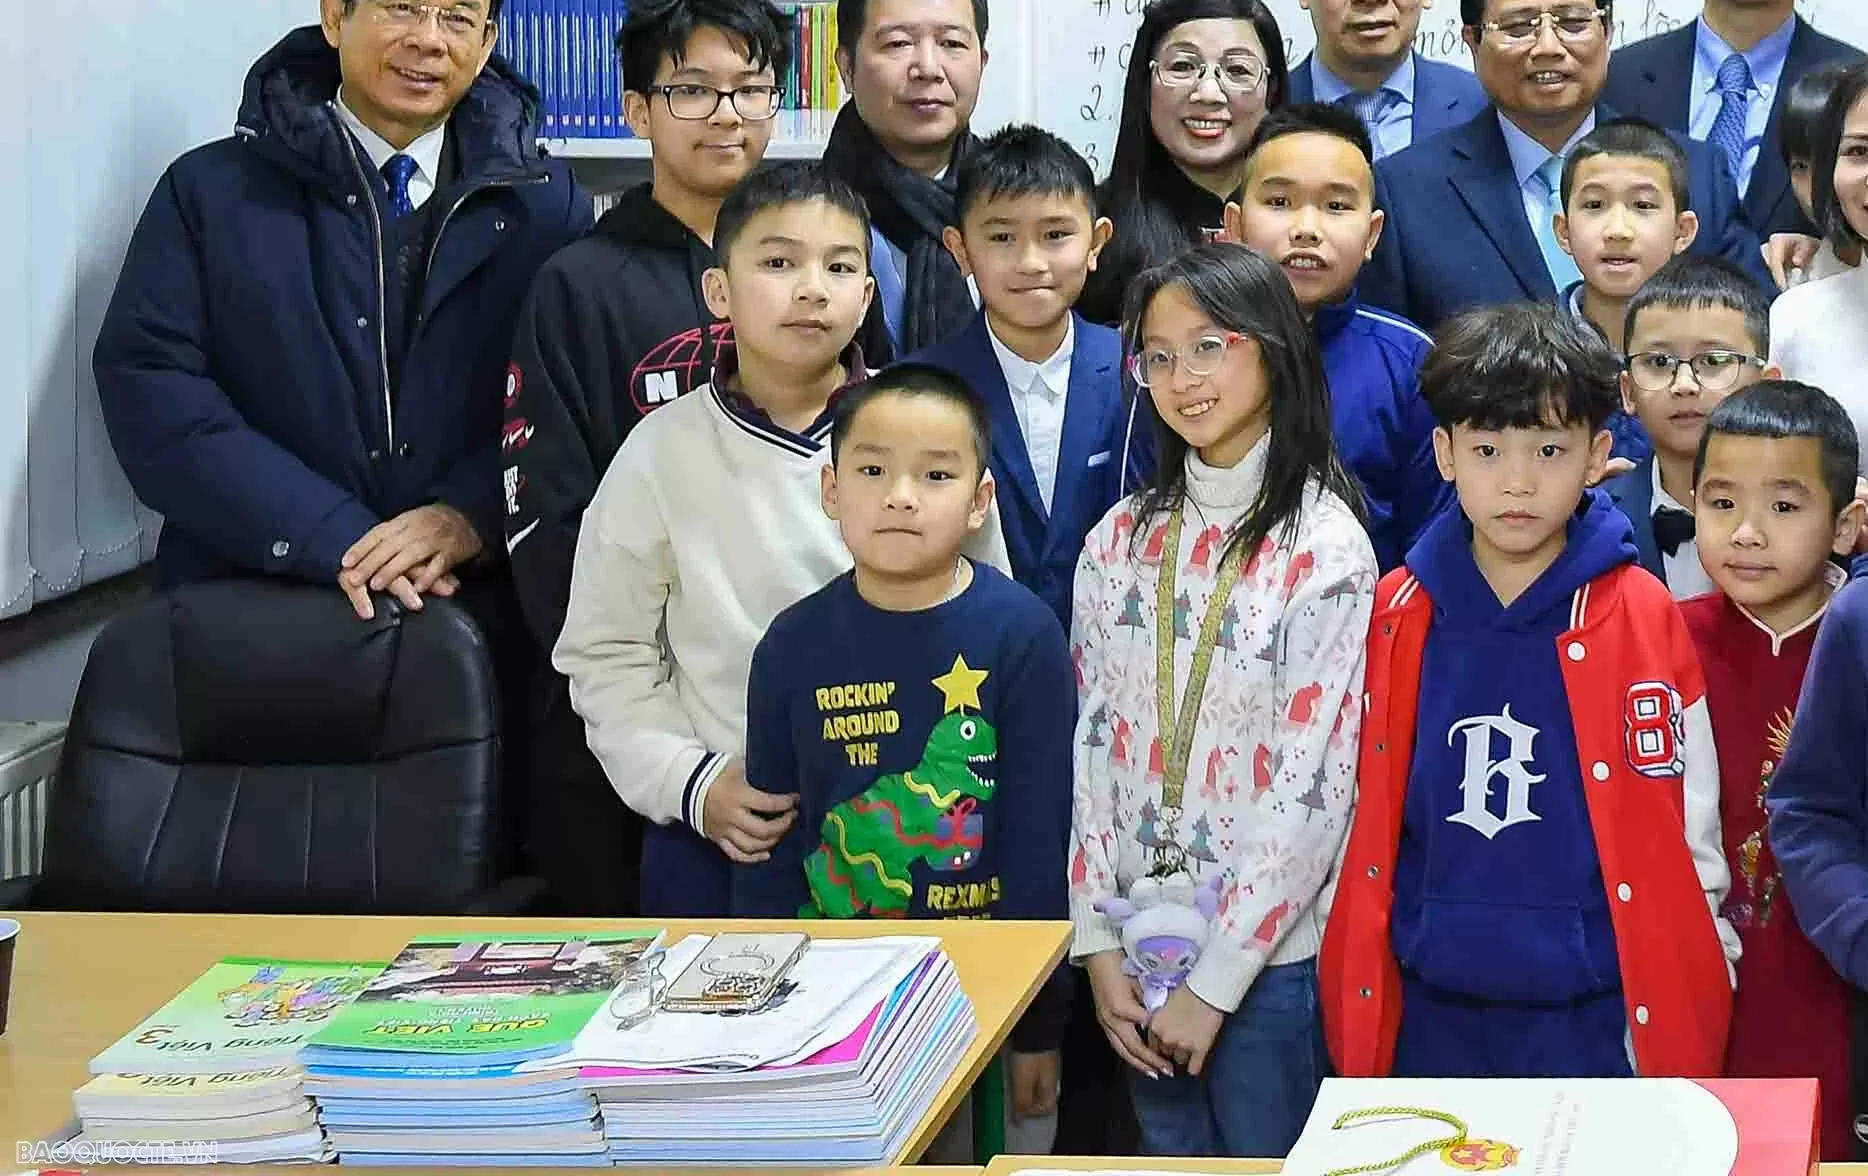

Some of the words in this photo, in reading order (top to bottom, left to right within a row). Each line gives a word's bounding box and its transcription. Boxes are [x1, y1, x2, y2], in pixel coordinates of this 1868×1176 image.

[816, 682, 895, 711] ROCKIN'
[823, 710, 899, 741] AROUND
[846, 742, 879, 766] THE
